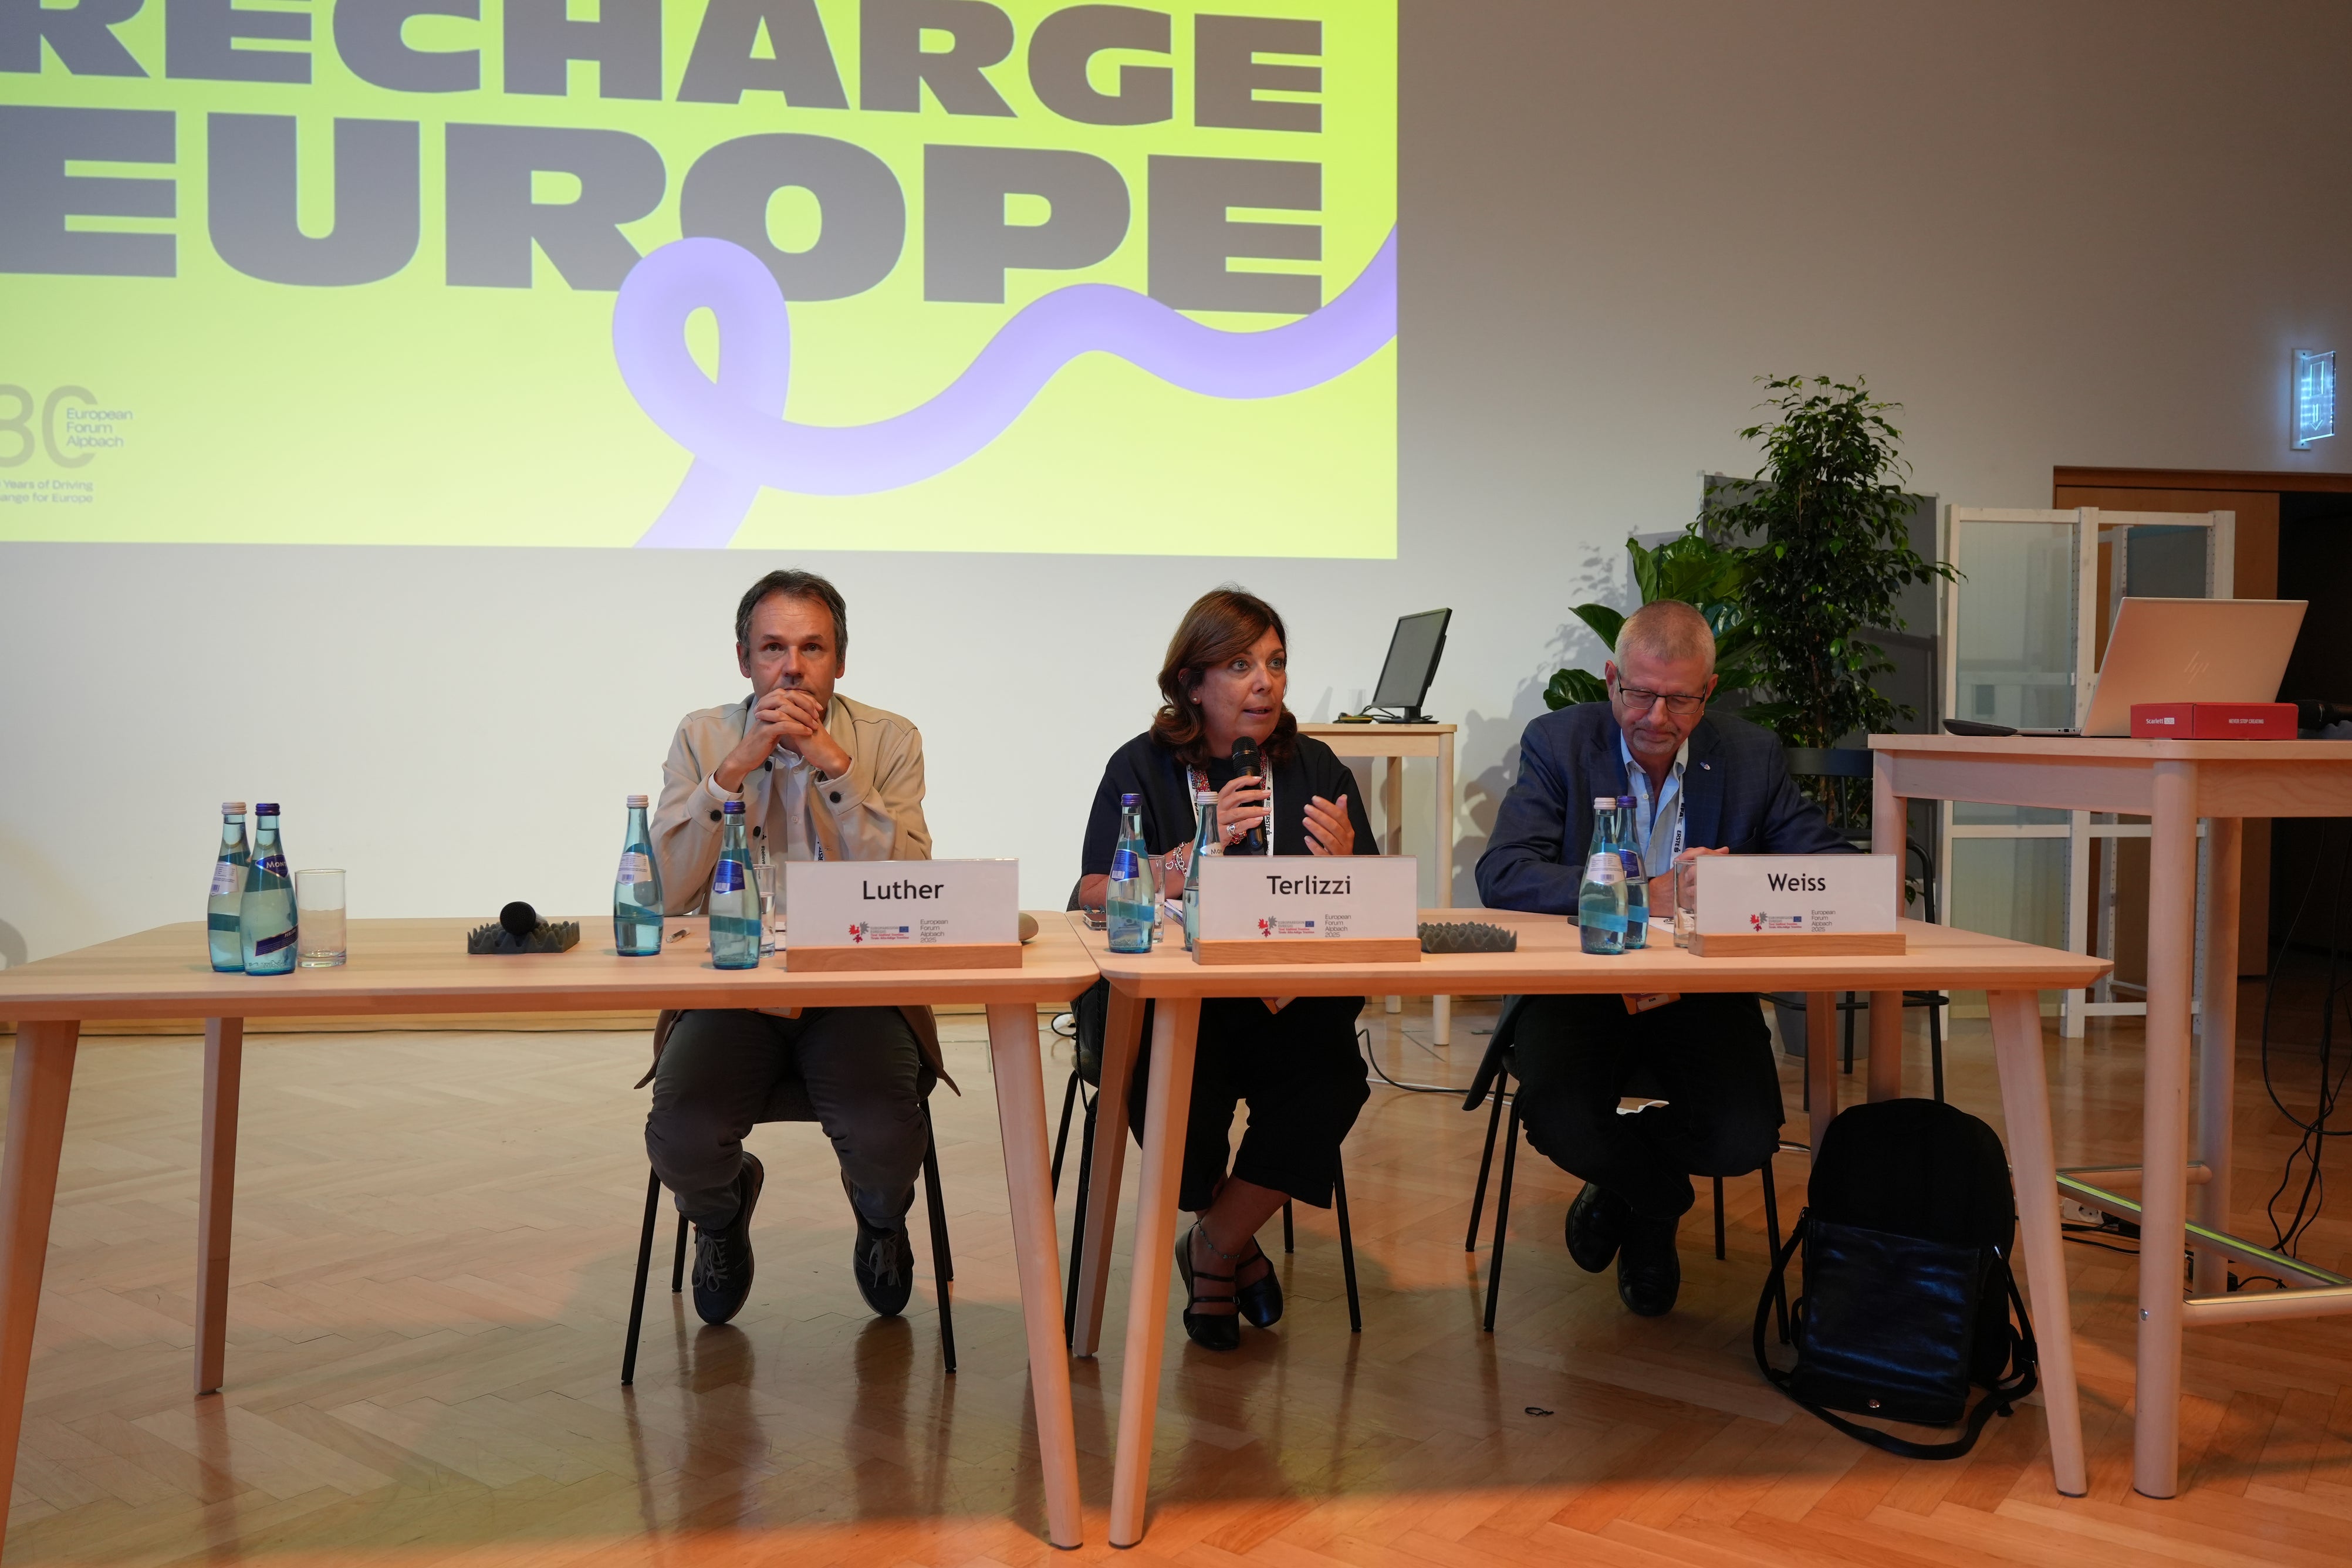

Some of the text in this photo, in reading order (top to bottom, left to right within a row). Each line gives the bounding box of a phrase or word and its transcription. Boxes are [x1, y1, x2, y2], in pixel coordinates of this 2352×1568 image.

[0, 0, 1322, 133] RECHARGE
[0, 104, 1322, 315] EUROPE
[66, 407, 133, 421] European
[66, 421, 113, 434] Forum
[66, 435, 124, 448] Alpbach
[4, 480, 34, 489] Years
[37, 480, 49, 489] of
[52, 480, 93, 492] Driving
[33, 493, 49, 502] for
[52, 494, 93, 503] Europe
[863, 880, 944, 900] Luther
[1266, 875, 1351, 895] Terlizzi
[1767, 873, 1826, 892] Weiss
